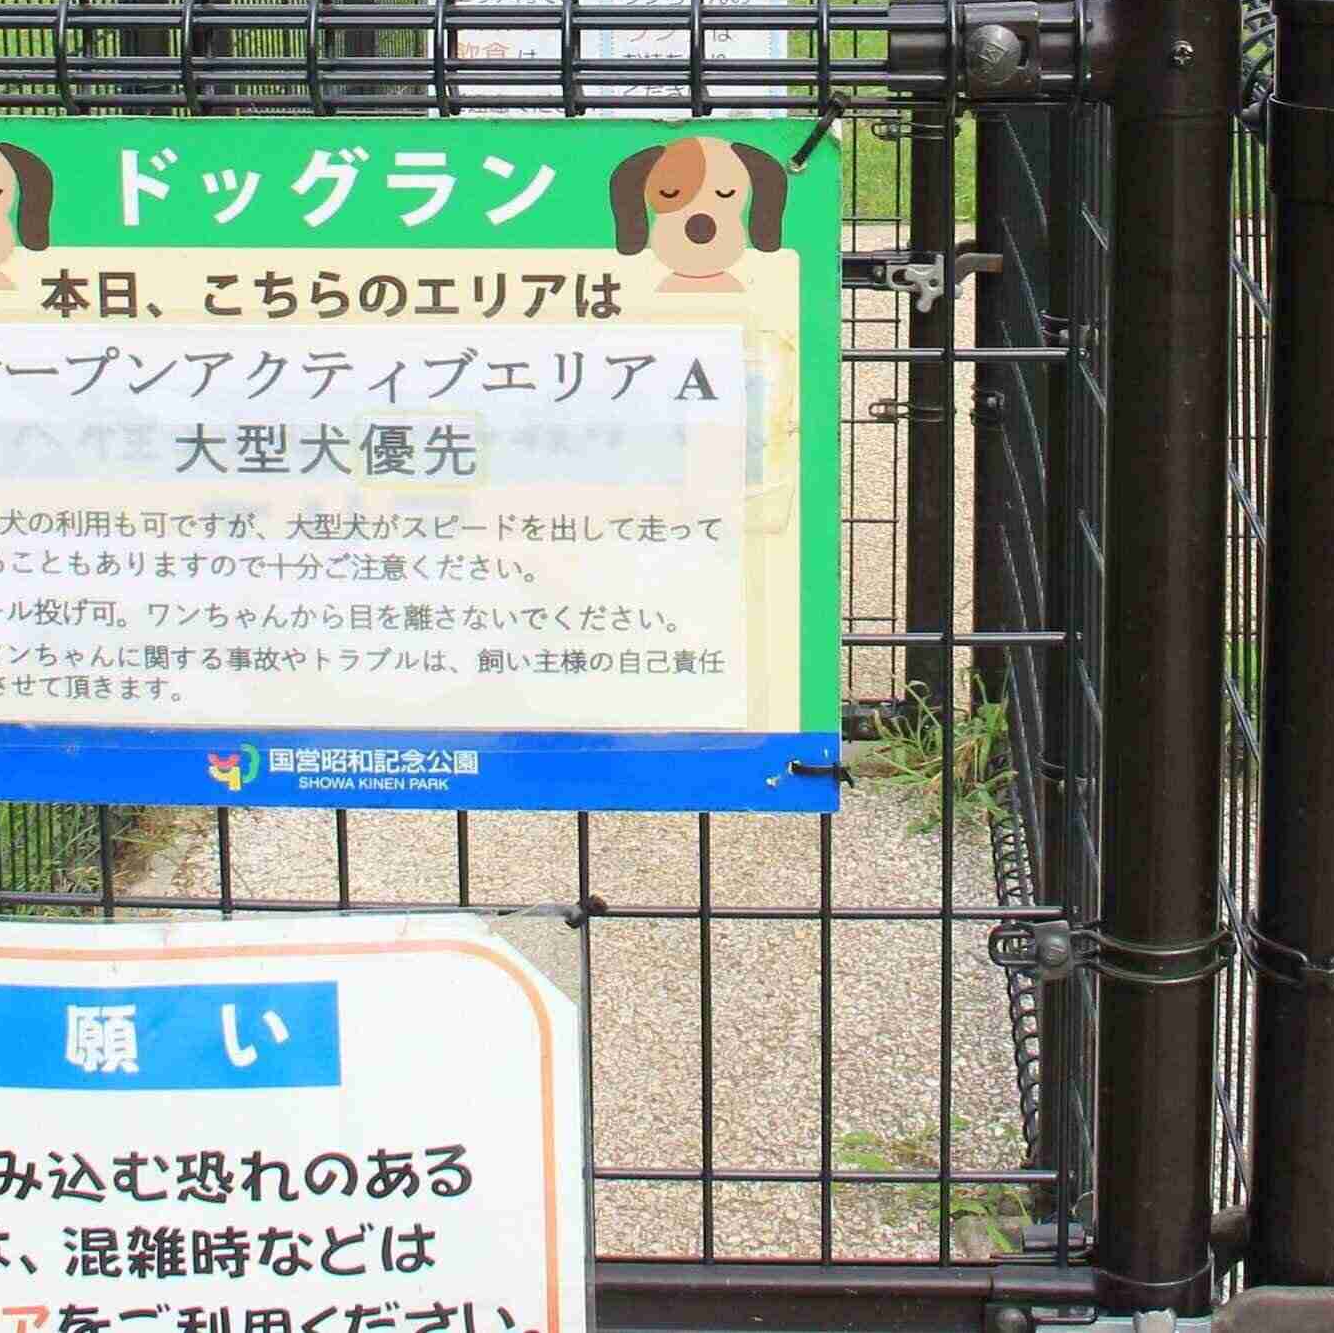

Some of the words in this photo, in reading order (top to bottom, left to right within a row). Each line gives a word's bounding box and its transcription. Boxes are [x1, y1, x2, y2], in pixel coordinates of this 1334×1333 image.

[119, 146, 557, 229] ドッグラン
[41, 268, 622, 320] 本日、こちらのエリアは
[175, 423, 478, 476] 大型犬優先
[269, 748, 479, 775] 国営昭和記念公園
[298, 776, 355, 790] SHOWA
[358, 777, 406, 790] KINEN
[409, 777, 449, 790] PARK
